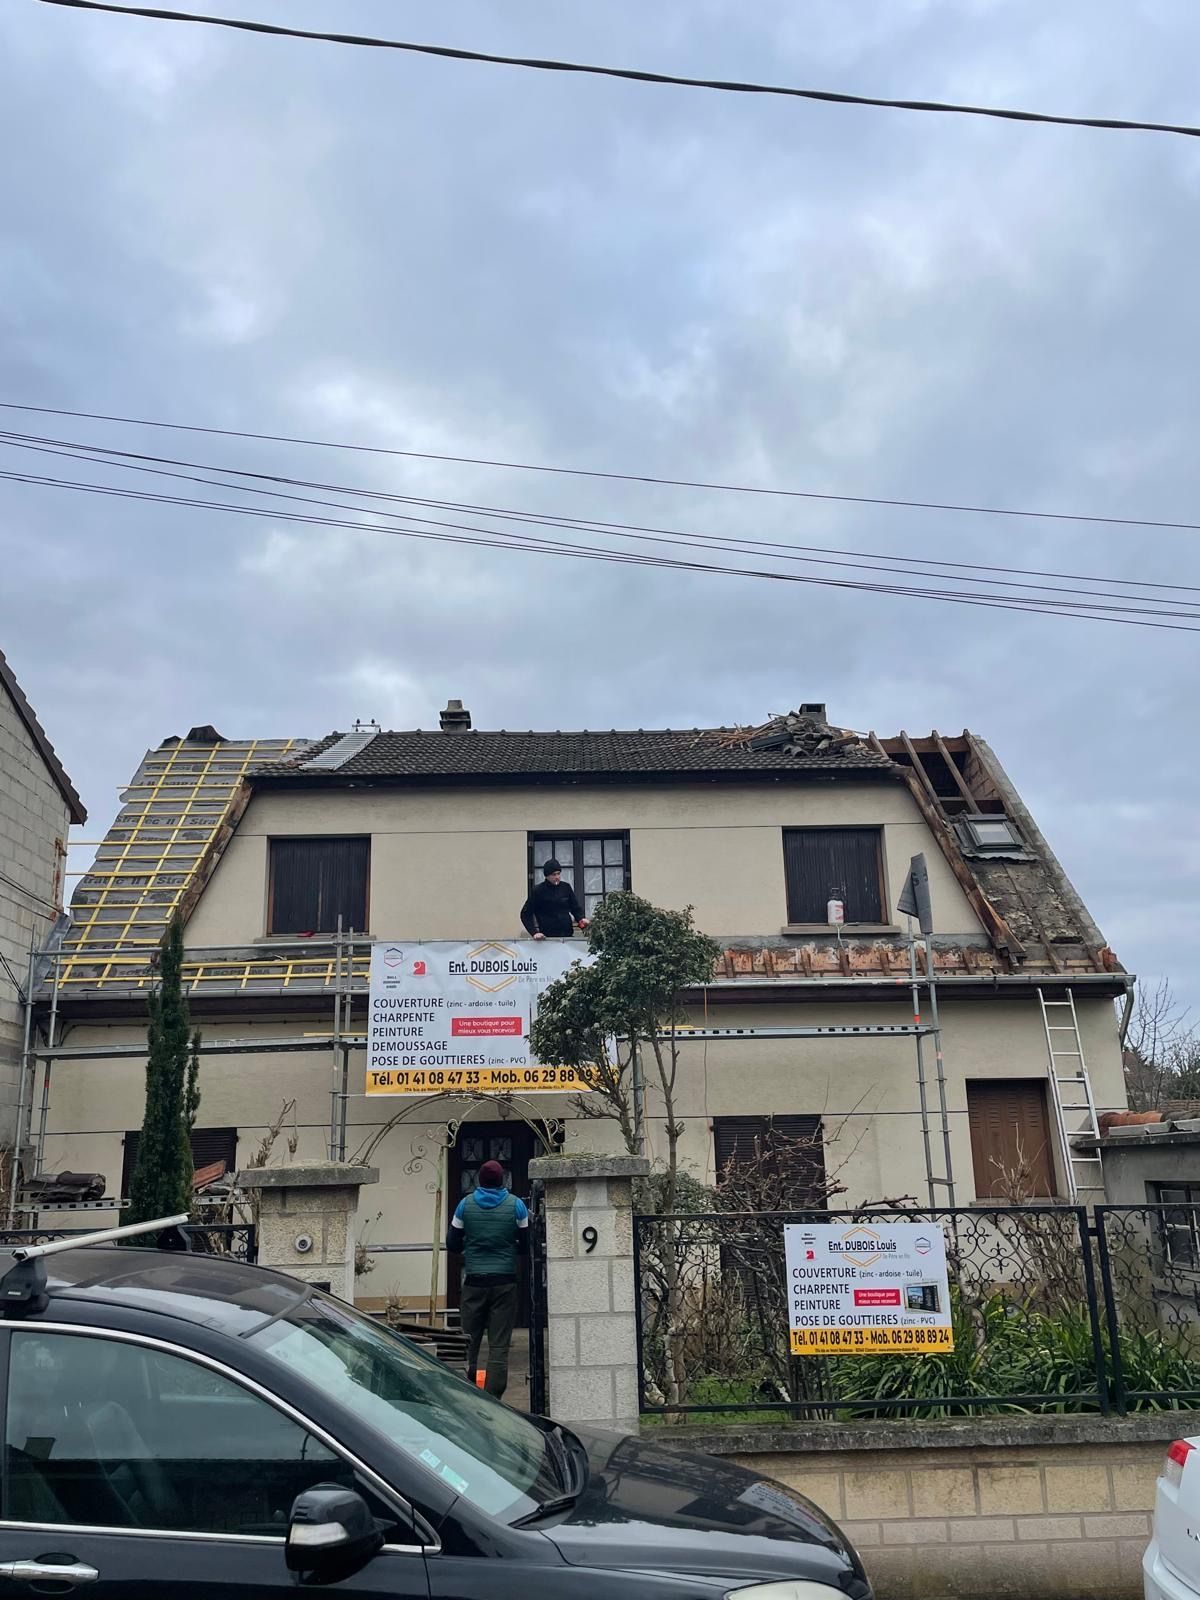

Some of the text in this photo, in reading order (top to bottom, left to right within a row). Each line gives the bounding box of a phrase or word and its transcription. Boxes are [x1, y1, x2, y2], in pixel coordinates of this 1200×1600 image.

[449, 958, 537, 973] Ent. DUBOIS Louis
[373, 998, 444, 1008] COUVERTURE
[446, 1000, 463, 1008] (zinc
[498, 1000, 516, 1008] tuile)
[373, 1012, 435, 1023] CHARPENTE
[372, 1027, 424, 1037] PEINTURE
[372, 1041, 448, 1051] DEMOUSSAGE
[371, 1056, 398, 1066] POSE
[402, 1056, 416, 1065] DE
[420, 1055, 485, 1065] GOUTTIERES
[488, 1057, 504, 1065] (zinc
[510, 1056, 527, 1065] PVC)
[372, 1072, 393, 1085] Tél.
[397, 1072, 409, 1085] 01
[413, 1072, 425, 1085] 41
[429, 1072, 444, 1084] 08
[448, 1071, 463, 1084] 47
[466, 1071, 479, 1084] 33
[491, 1070, 520, 1083] Mob.
[524, 1070, 538, 1082] 06
[542, 1070, 556, 1082] 29
[560, 1069, 574, 1082] 88
[583, 1226, 597, 1253] 9
[828, 1239, 897, 1251] Ent. DUBOIS Louis
[792, 1267, 857, 1278] COUVERTURE
[859, 1271, 874, 1279] (zinc
[878, 1269, 901, 1277] ardoise
[906, 1269, 923, 1278] tuile)
[793, 1284, 850, 1295] CHARPENTE
[794, 1300, 841, 1310] PEINTURE
[795, 1316, 820, 1326] POSE
[823, 1315, 836, 1325] DE
[839, 1314, 898, 1325] GOUTTIERES
[901, 1317, 916, 1325] (zinc
[920, 1317, 936, 1325] PVC)
[793, 1331, 807, 1345] Tél.
[809, 1331, 818, 1345] 01
[820, 1331, 828, 1345] 41
[830, 1331, 840, 1345] 08
[842, 1330, 852, 1344] 47
[854, 1330, 863, 1344] 33
[870, 1330, 890, 1344] Mob.
[892, 1330, 902, 1344] 06
[904, 1329, 913, 1343] 29
[915, 1329, 925, 1343] 88
[927, 1329, 937, 1343] 89
[939, 1329, 949, 1343] 24
